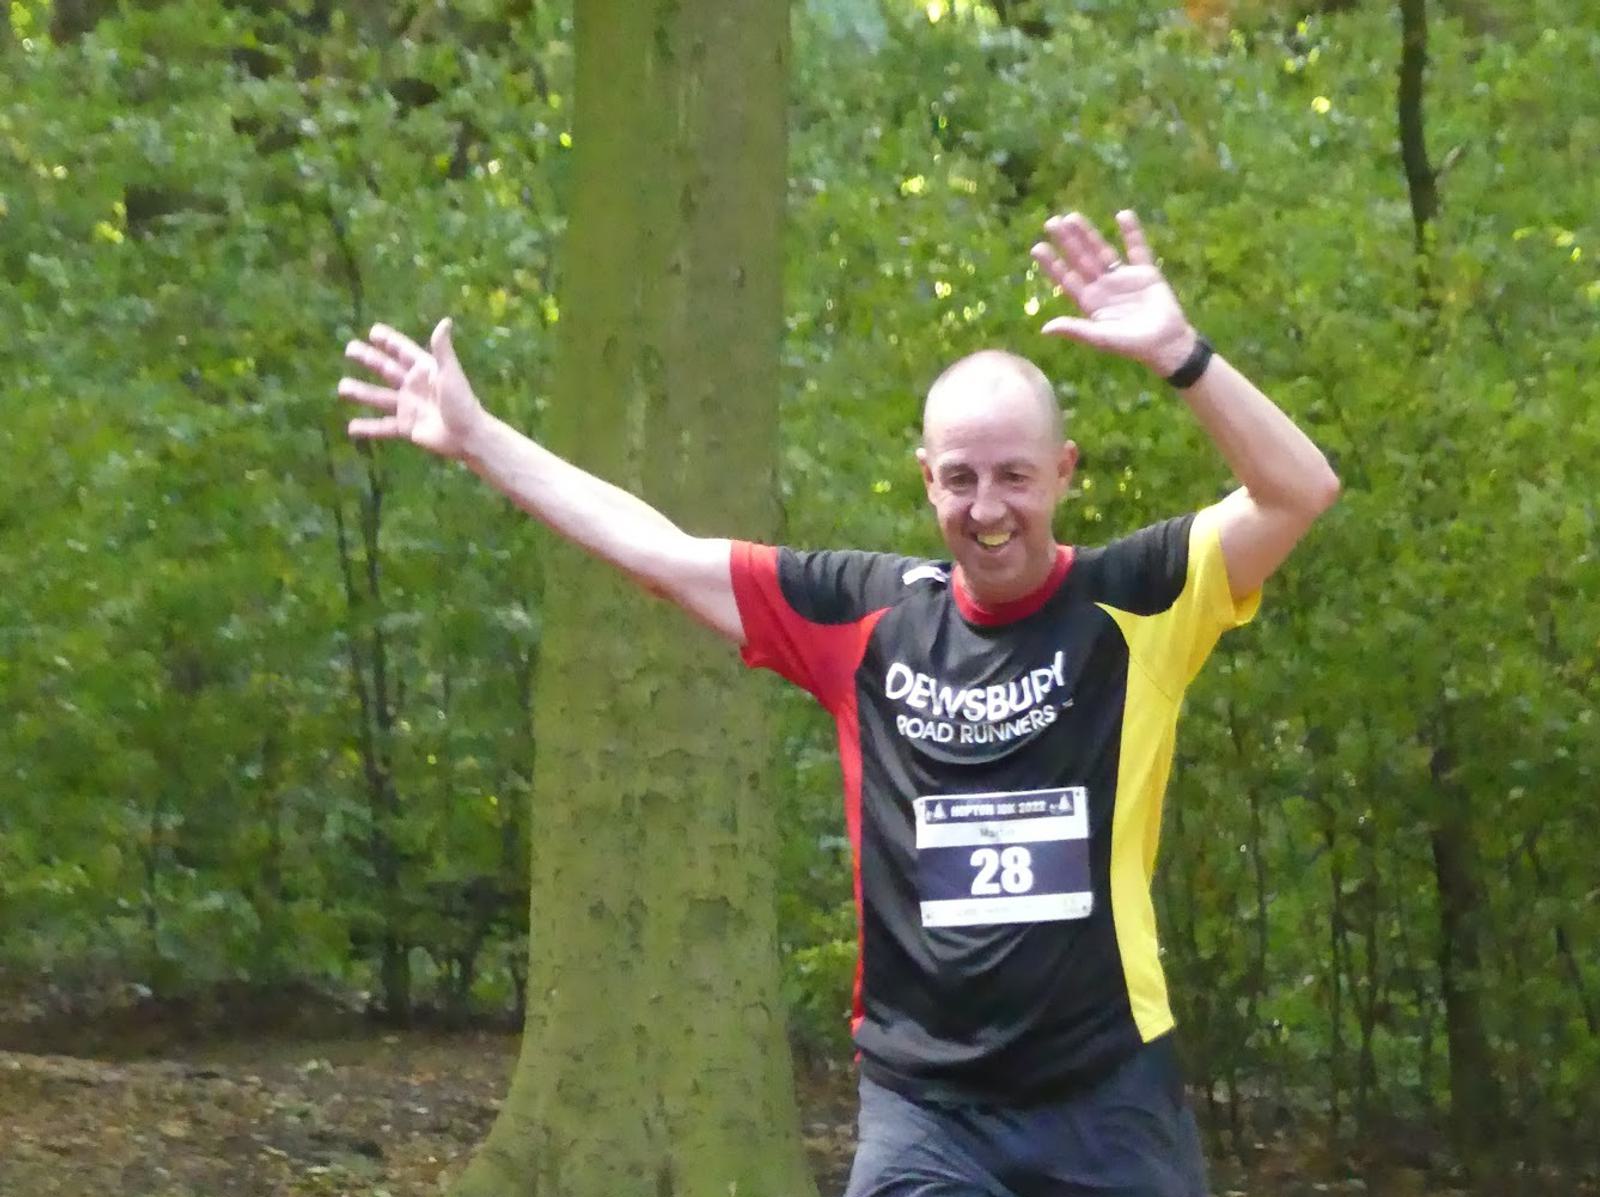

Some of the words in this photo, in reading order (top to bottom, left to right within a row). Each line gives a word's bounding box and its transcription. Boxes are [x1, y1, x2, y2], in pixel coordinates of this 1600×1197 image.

[896, 714, 954, 743] ROAD
[960, 704, 1058, 744] RUNNERS
[970, 846, 1034, 895] 28
